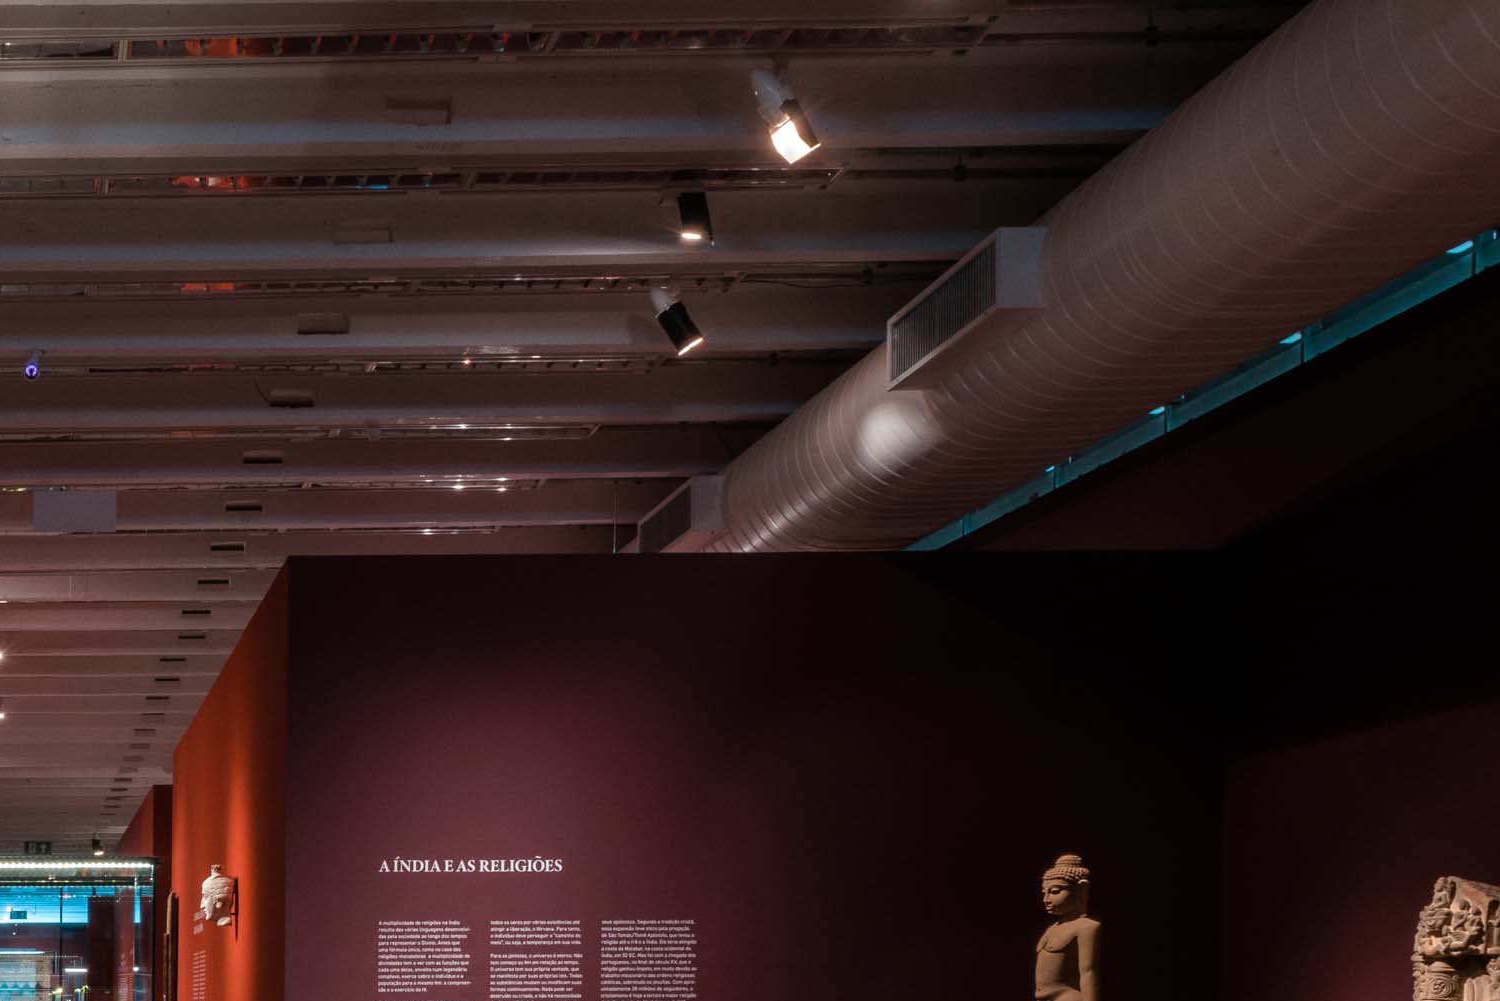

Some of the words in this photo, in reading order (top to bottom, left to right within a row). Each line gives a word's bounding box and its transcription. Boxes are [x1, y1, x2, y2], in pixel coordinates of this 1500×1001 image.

[378, 860, 391, 873] A
[393, 856, 442, 873] ÍNDIA
[443, 860, 454, 873] E
[455, 860, 476, 873] AS
[478, 855, 563, 873] RELIGIÕES
